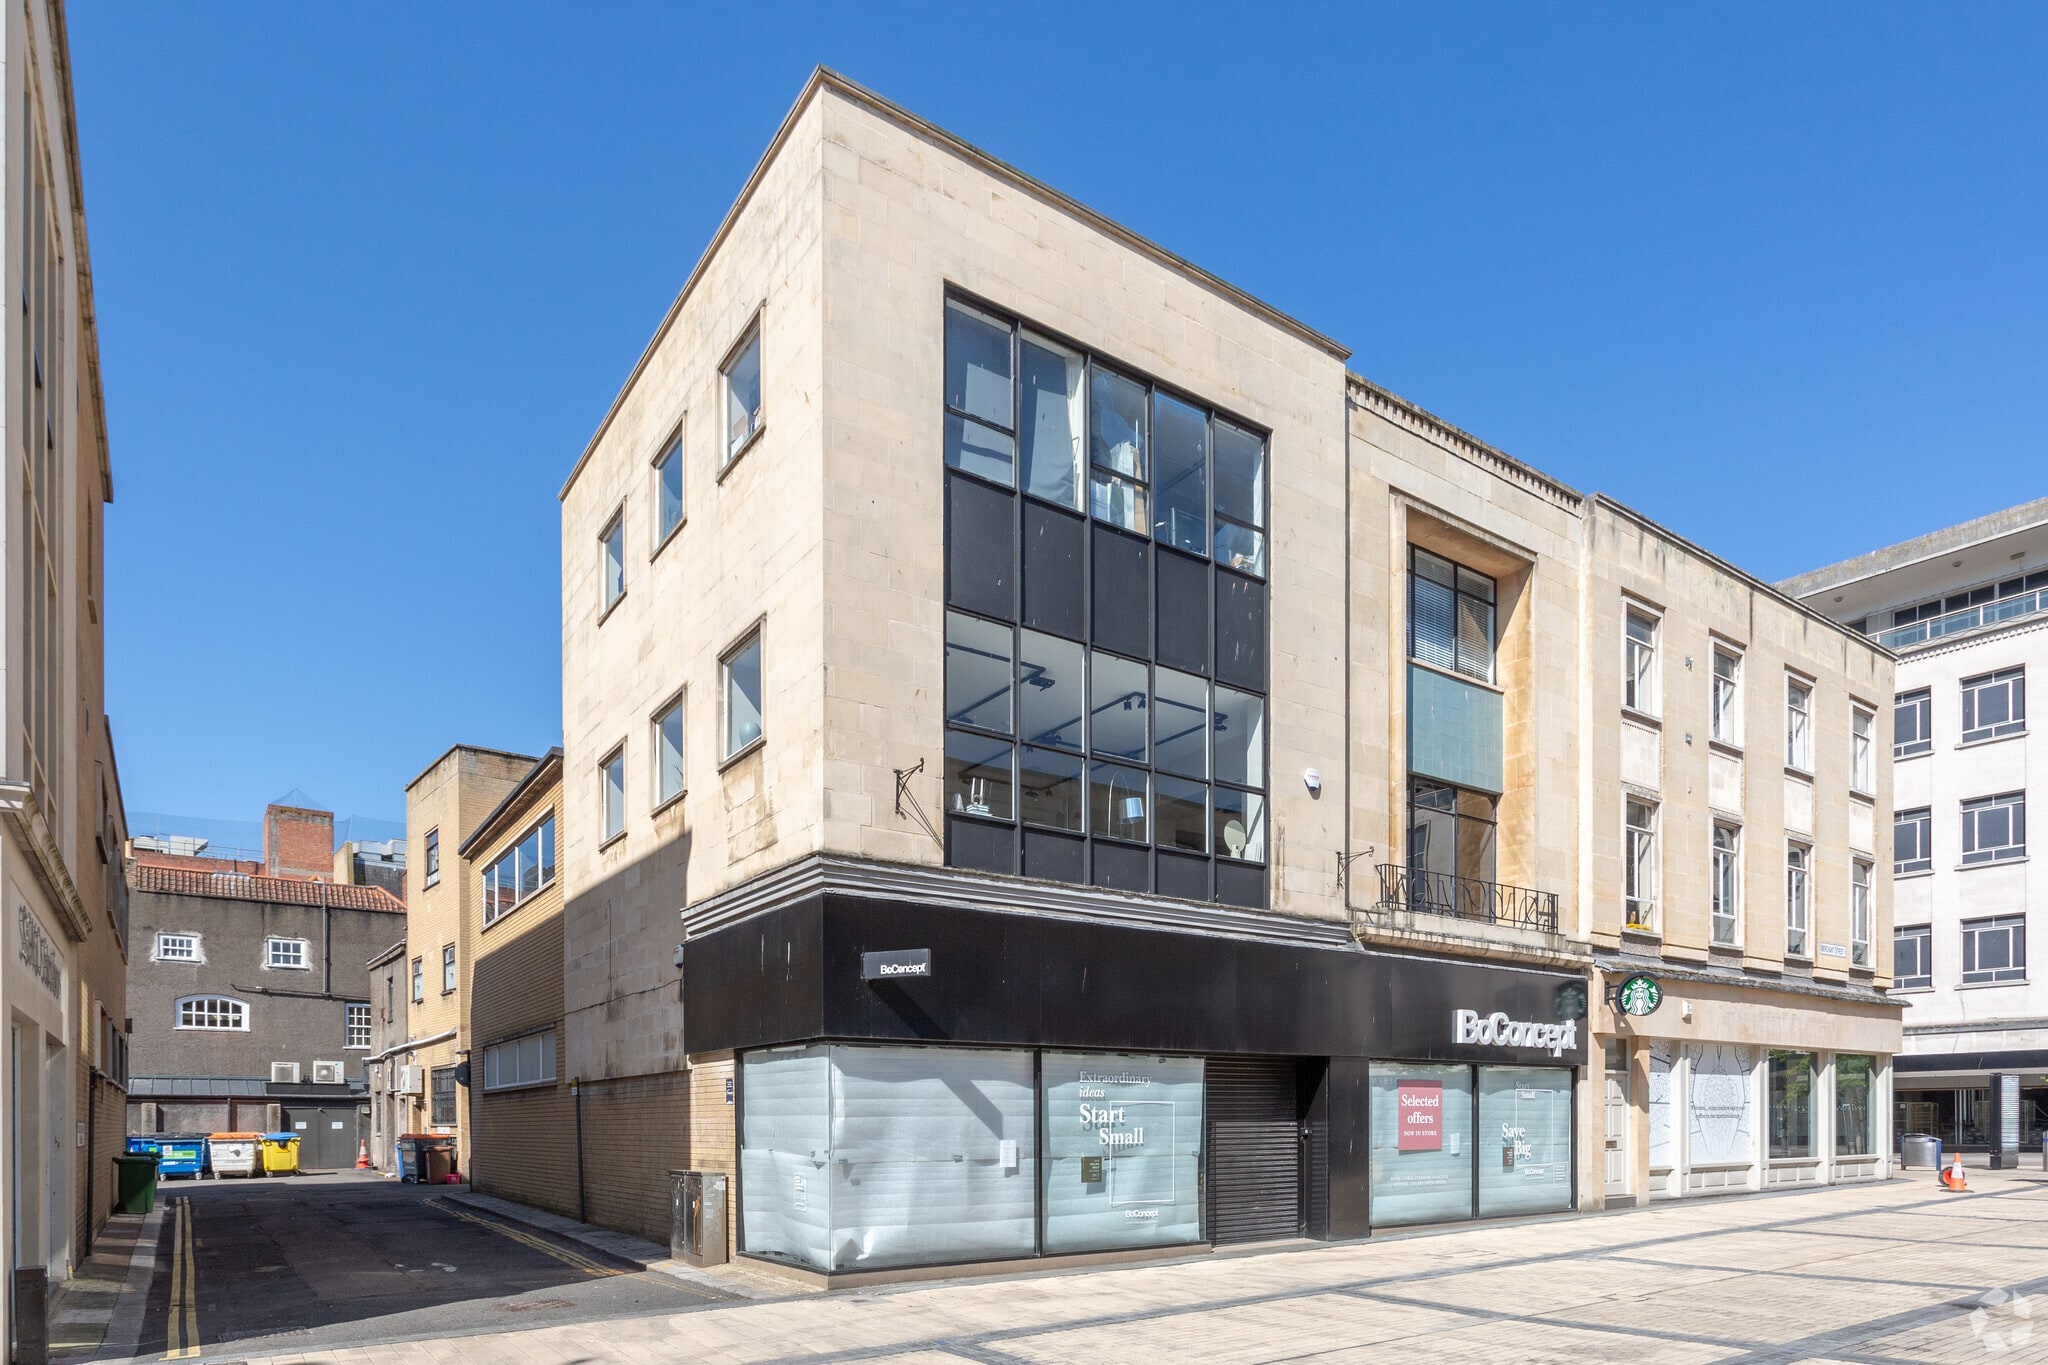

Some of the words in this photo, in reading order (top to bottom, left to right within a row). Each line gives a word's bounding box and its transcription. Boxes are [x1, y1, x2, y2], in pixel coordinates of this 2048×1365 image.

[880, 962, 927, 975] BoConcept
[1453, 1008, 1577, 1057] BoConcept
[1079, 1071, 1152, 1088] Extraordinary
[1079, 1086, 1105, 1098] ideas
[1401, 1094, 1439, 1107] Selected
[1079, 1103, 1126, 1123] Start
[1407, 1111, 1434, 1124] offers
[1099, 1127, 1144, 1145] Small
[1502, 1123, 1525, 1138] Save
[1514, 1140, 1532, 1160] Big
[1125, 1208, 1159, 1219] BoConcept
